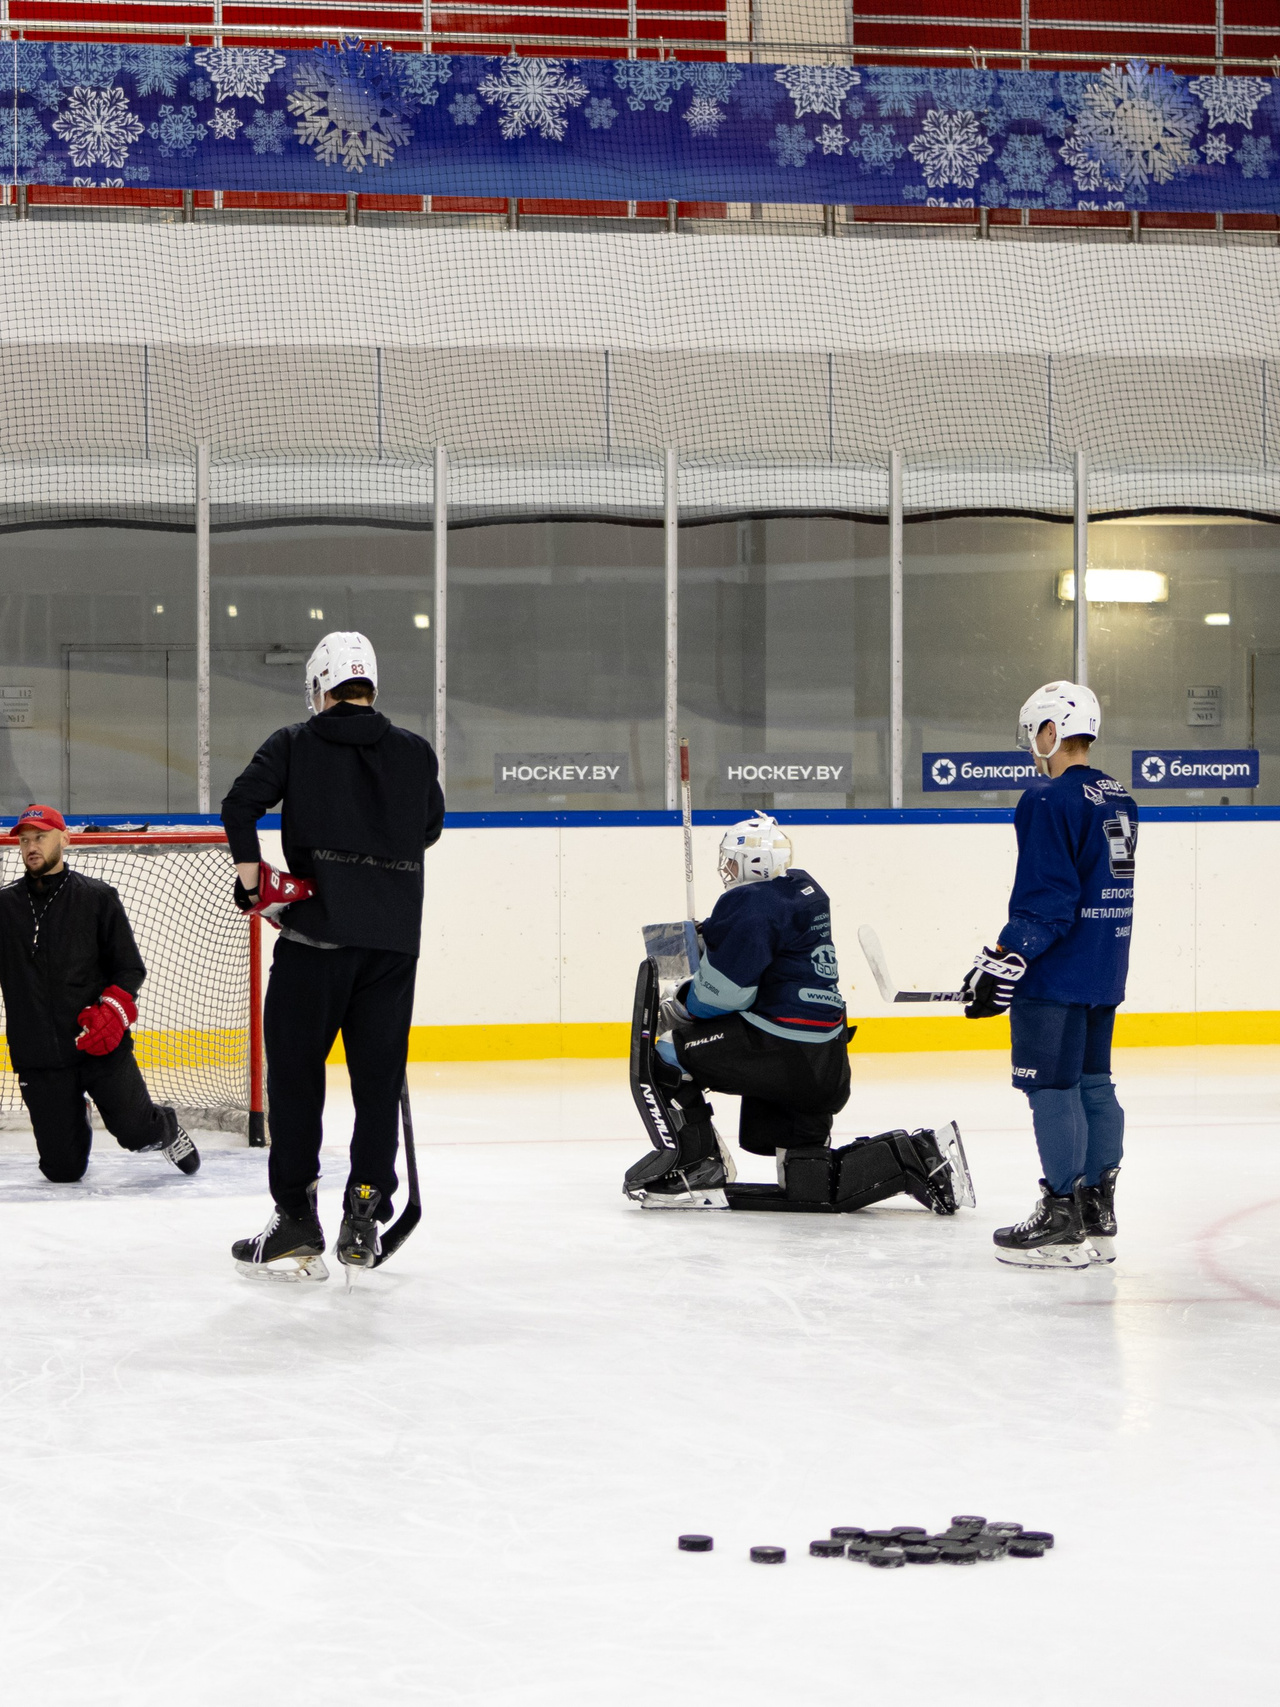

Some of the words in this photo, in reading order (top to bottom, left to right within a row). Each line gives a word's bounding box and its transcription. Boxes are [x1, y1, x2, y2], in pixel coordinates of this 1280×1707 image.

[351, 664, 365, 675] 83
[502, 765, 620, 781] HOCKEY.BY
[727, 765, 844, 780] HOCKEY.BY
[1170, 760, 1250, 781] белкарт
[929, 992, 964, 1002] CCM
[1012, 1066, 1037, 1079] UER
